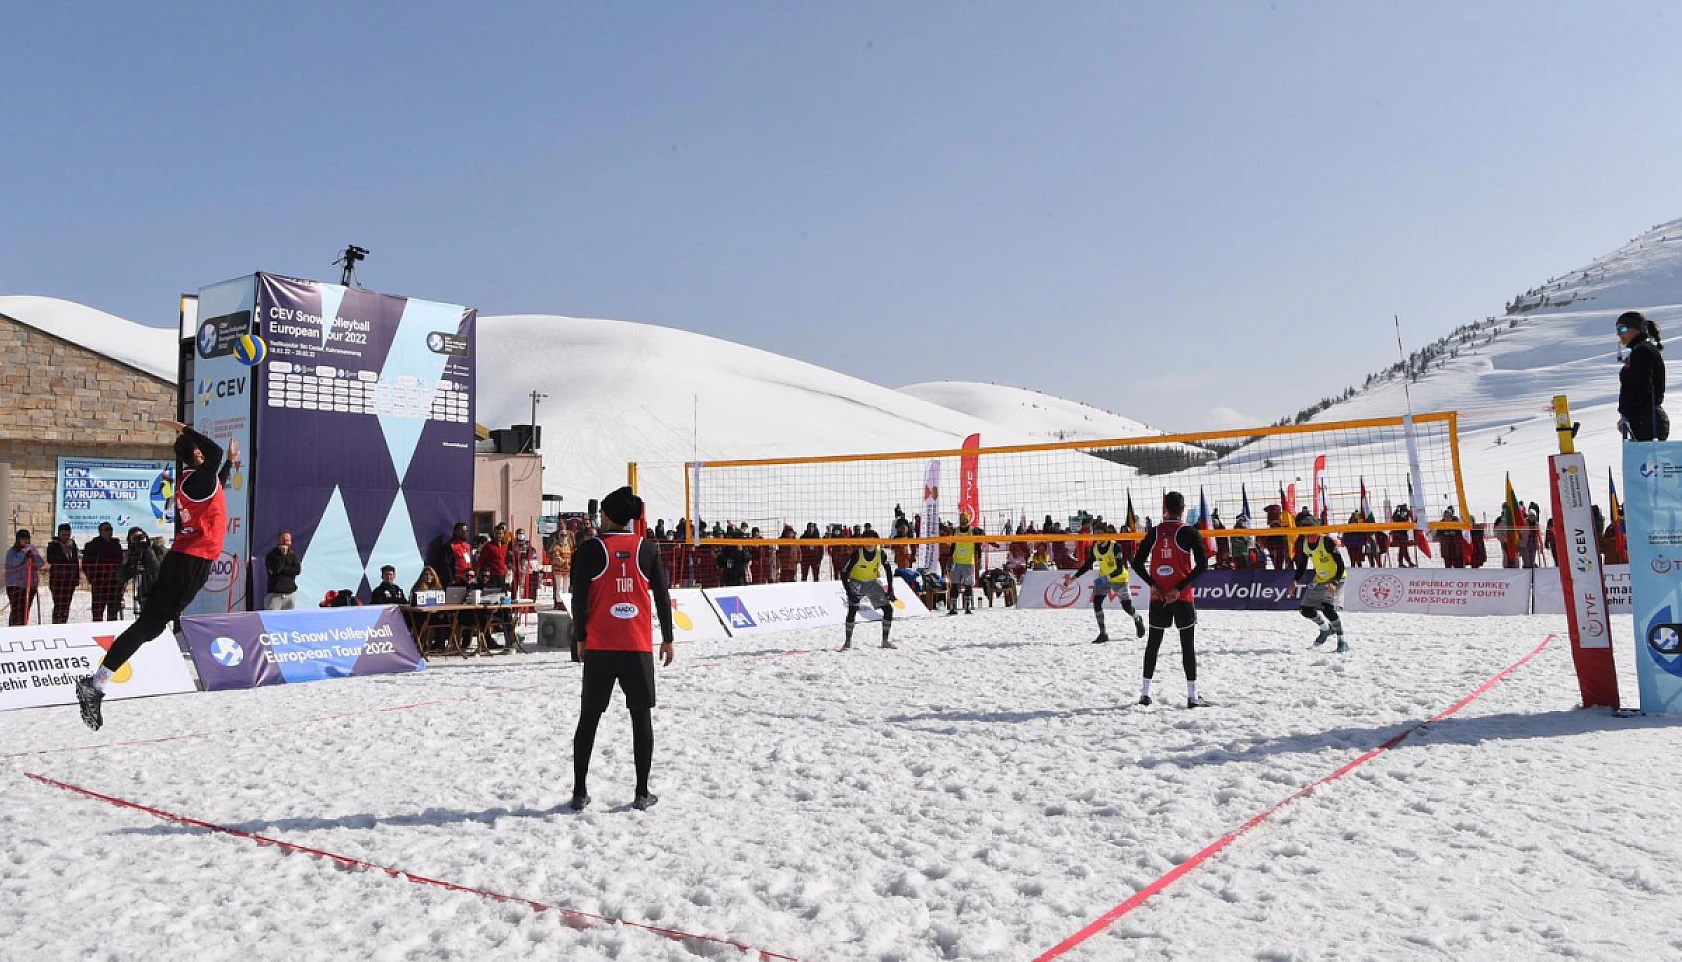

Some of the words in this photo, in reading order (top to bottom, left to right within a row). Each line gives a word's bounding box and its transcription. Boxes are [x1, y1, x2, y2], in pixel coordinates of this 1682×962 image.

[269, 306, 294, 320] CEV
[295, 310, 323, 324] Snow
[269, 321, 320, 338] European
[345, 331, 367, 344] 2022
[217, 377, 246, 397] CEV
[65, 479, 88, 489] KAR
[90, 480, 149, 490] VOLEYBOLU
[65, 490, 107, 499] AVRUPA
[110, 490, 136, 500] TURU
[64, 501, 88, 509] 2022
[1574, 528, 1588, 555] CEV
[209, 560, 232, 576] ADO
[621, 562, 627, 577] 1
[615, 577, 634, 593] TUR
[1192, 581, 1307, 602] uroVolley.T
[1472, 581, 1511, 590] TURKEY
[1430, 597, 1468, 605] SPORTS
[1456, 589, 1468, 597] OF
[1471, 590, 1506, 598] YOUTH
[1584, 593, 1599, 618] TVF
[757, 609, 782, 624] AXA
[259, 633, 287, 646] CEV
[293, 630, 328, 643] Snow
[330, 624, 393, 642] Volleyball
[266, 649, 332, 664] European
[334, 646, 362, 657] Tour
[366, 641, 395, 654] 2022
[0, 655, 91, 674] manmaraş
